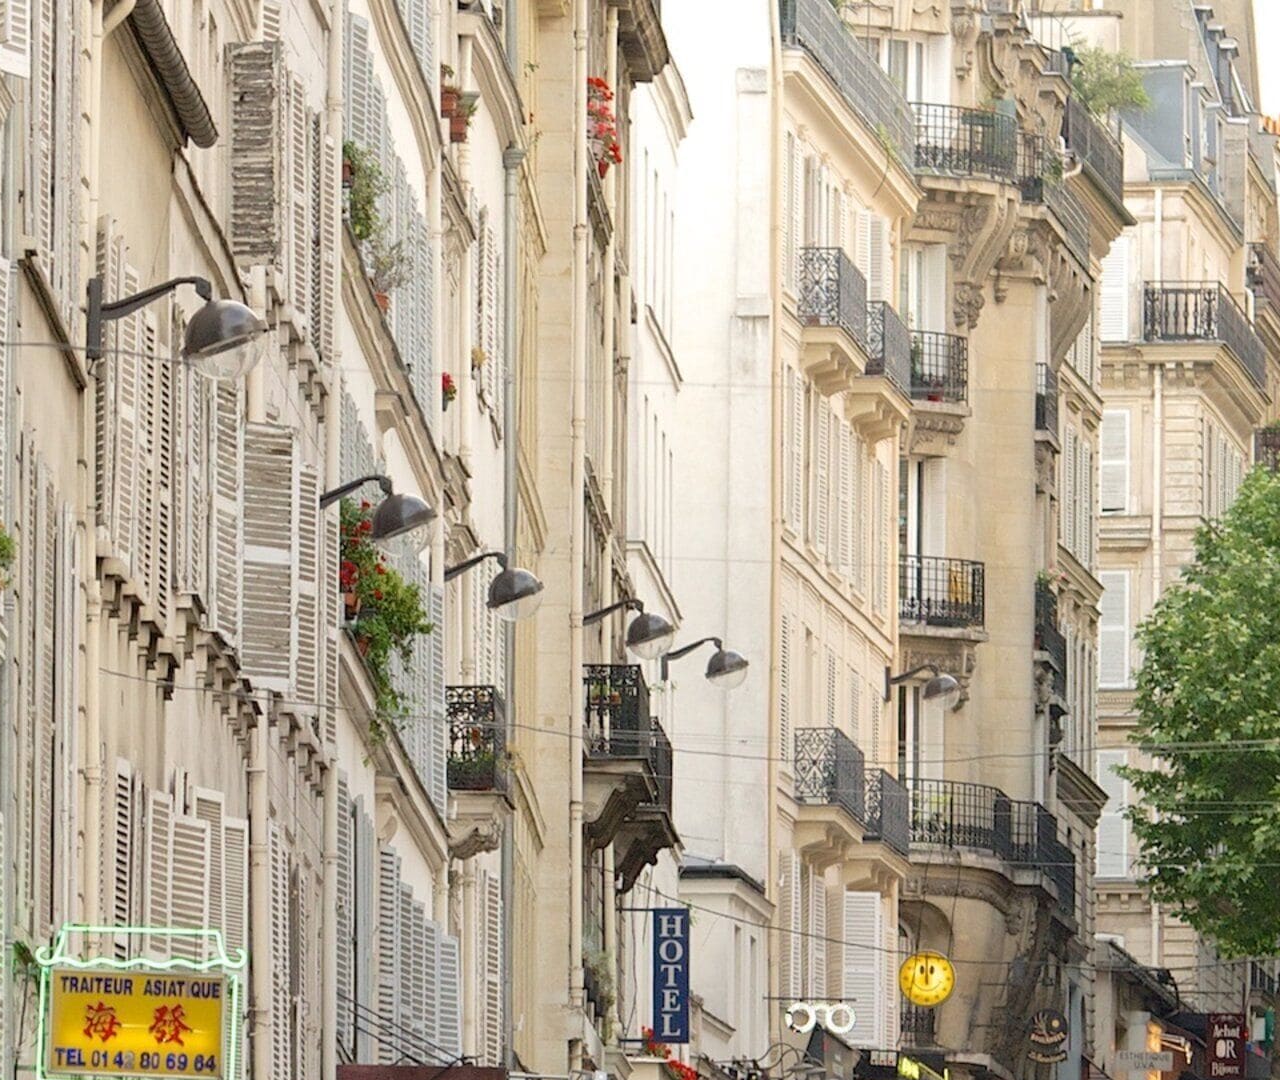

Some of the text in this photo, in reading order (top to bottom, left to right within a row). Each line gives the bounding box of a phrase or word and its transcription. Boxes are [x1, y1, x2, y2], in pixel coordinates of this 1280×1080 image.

[659, 915, 684, 1037] HOTEL
[61, 976, 220, 998] TRAITEUR ASIATIQUE
[55, 1048, 85, 1067] TEL
[1215, 1039, 1237, 1059] OR
